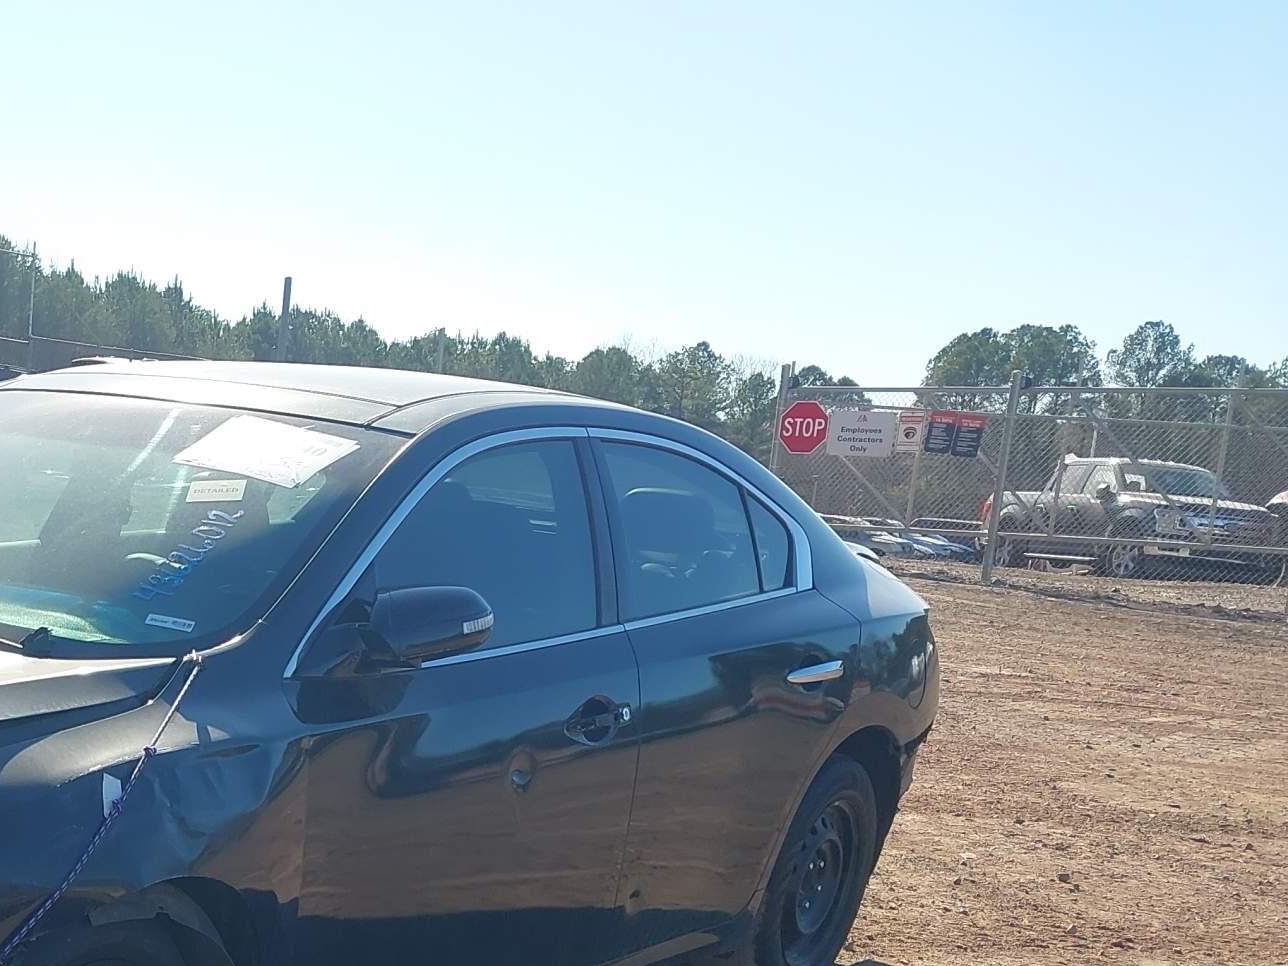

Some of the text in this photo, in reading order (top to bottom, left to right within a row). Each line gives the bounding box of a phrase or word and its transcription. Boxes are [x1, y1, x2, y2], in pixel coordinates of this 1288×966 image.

[782, 418, 825, 438] STOP
[840, 426, 882, 436] Employees
[837, 435, 883, 444] Contractors
[849, 445, 867, 453] Only
